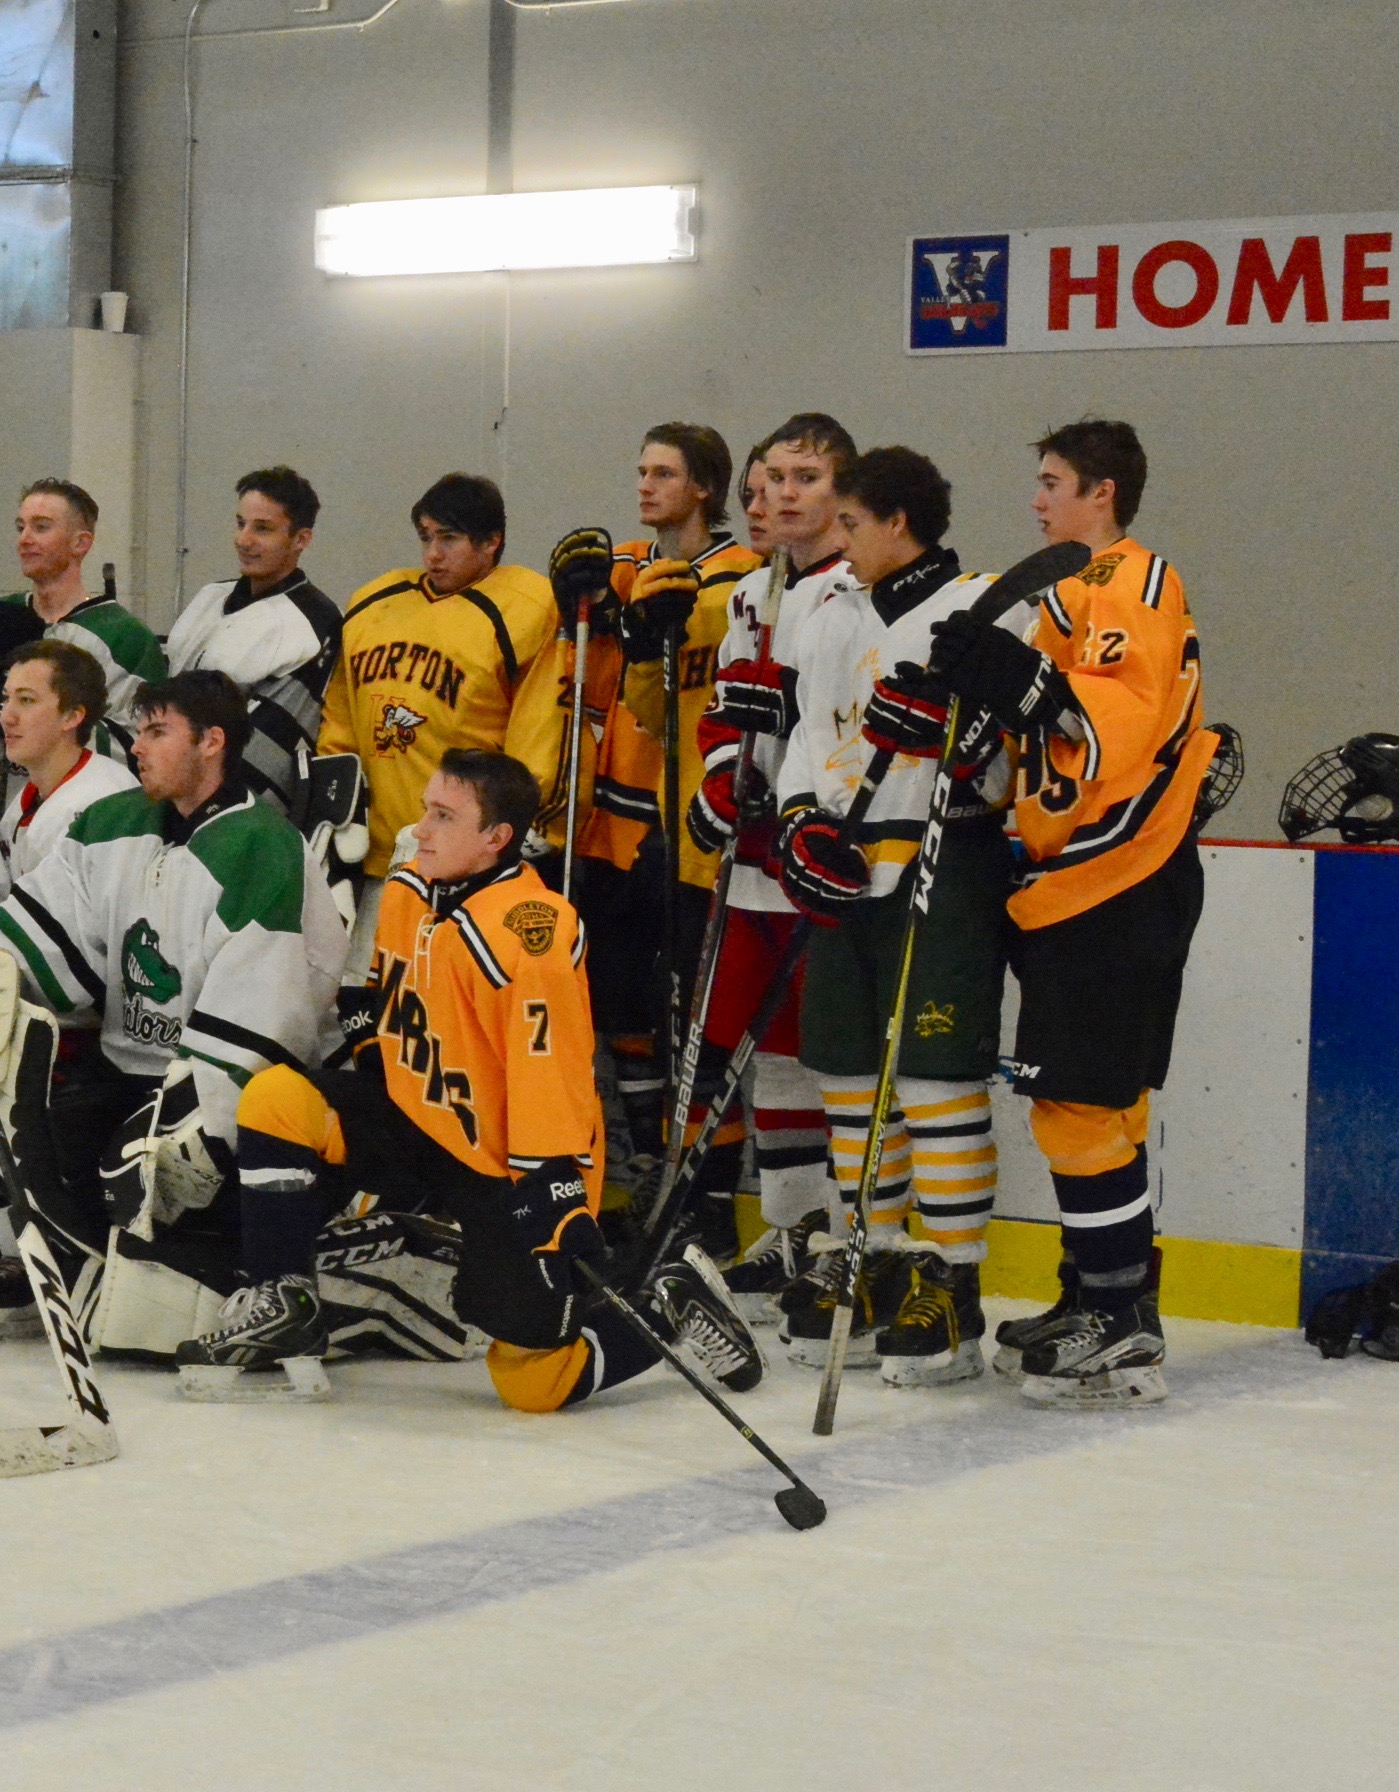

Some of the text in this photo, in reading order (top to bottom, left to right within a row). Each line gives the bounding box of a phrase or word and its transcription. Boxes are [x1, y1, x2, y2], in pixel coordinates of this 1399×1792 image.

[1048, 232, 1393, 331] HOME
[349, 640, 466, 710] HORTON
[524, 998, 552, 1057] 7
[673, 1022, 701, 1127] BAUER
[315, 1236, 406, 1272] CCM
[558, 1294, 574, 1338] Reebok
